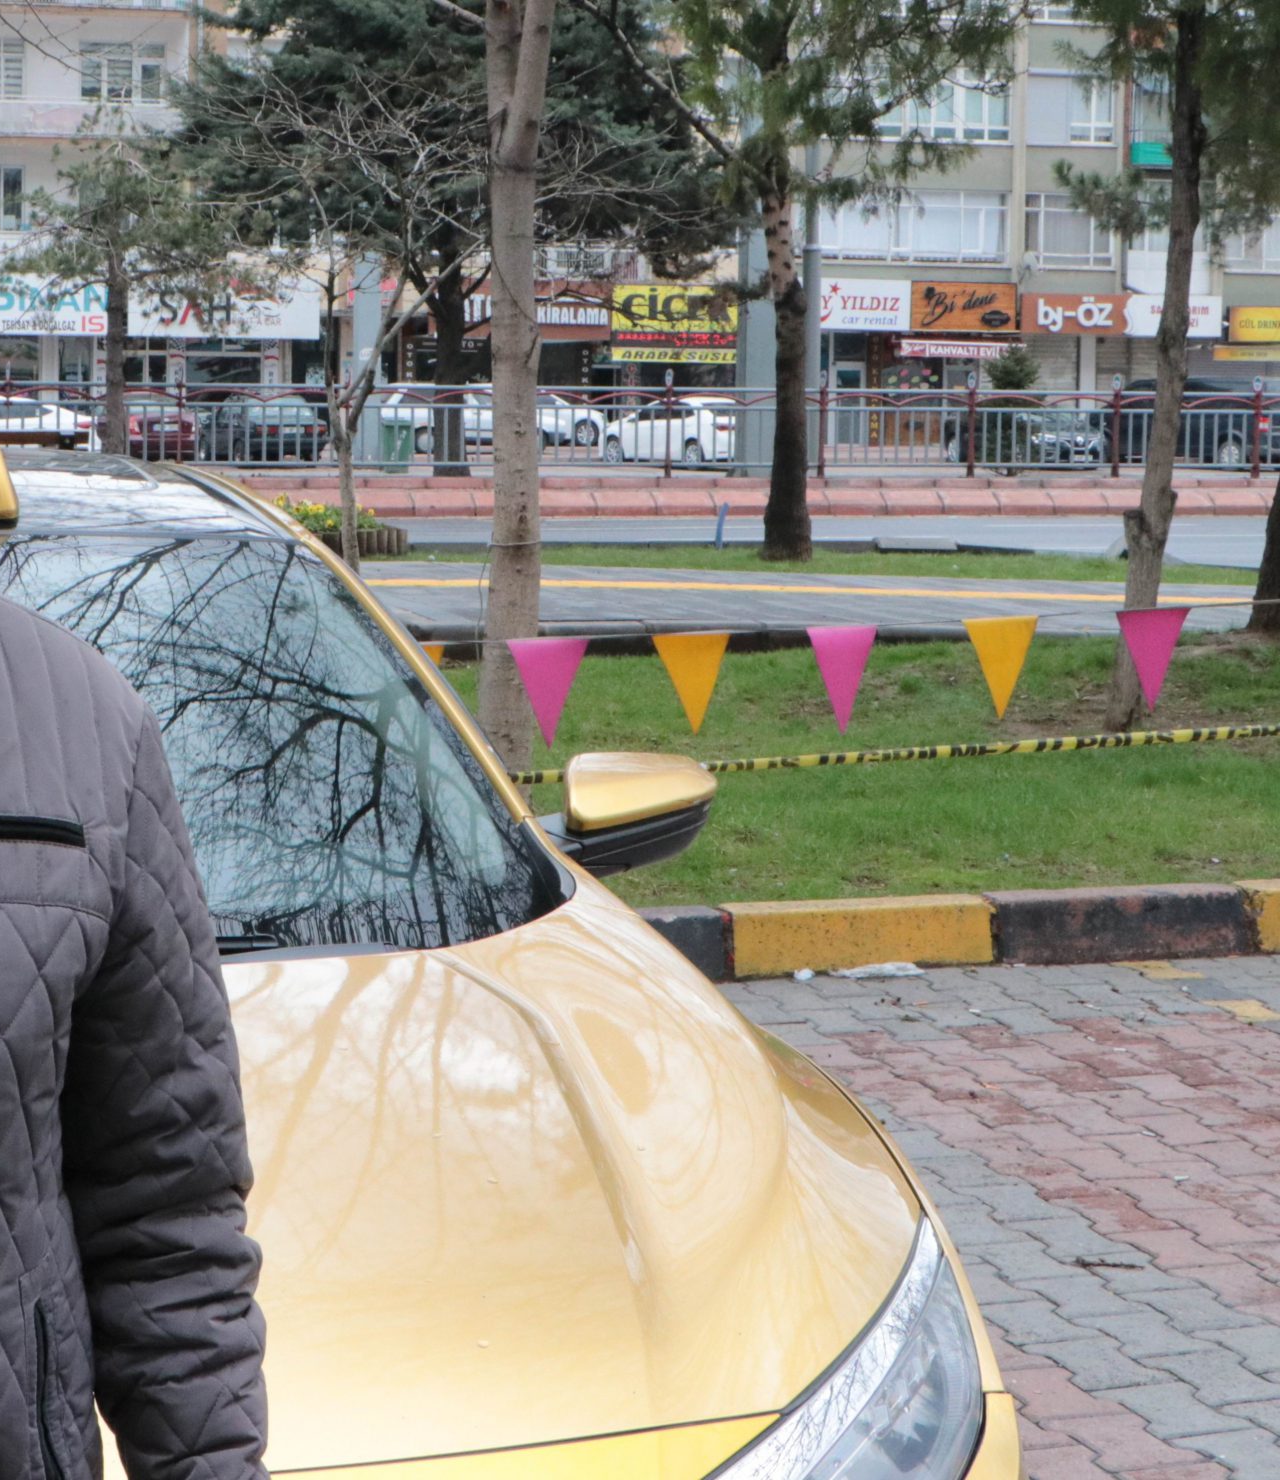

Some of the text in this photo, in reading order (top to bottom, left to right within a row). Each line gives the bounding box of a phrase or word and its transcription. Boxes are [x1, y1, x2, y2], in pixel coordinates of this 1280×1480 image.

[841, 296, 900, 312] YILDIZ
[537, 305, 609, 326] KİRALAMA
[842, 314, 898, 326] car rental
[930, 345, 977, 355] KAHVALTI
